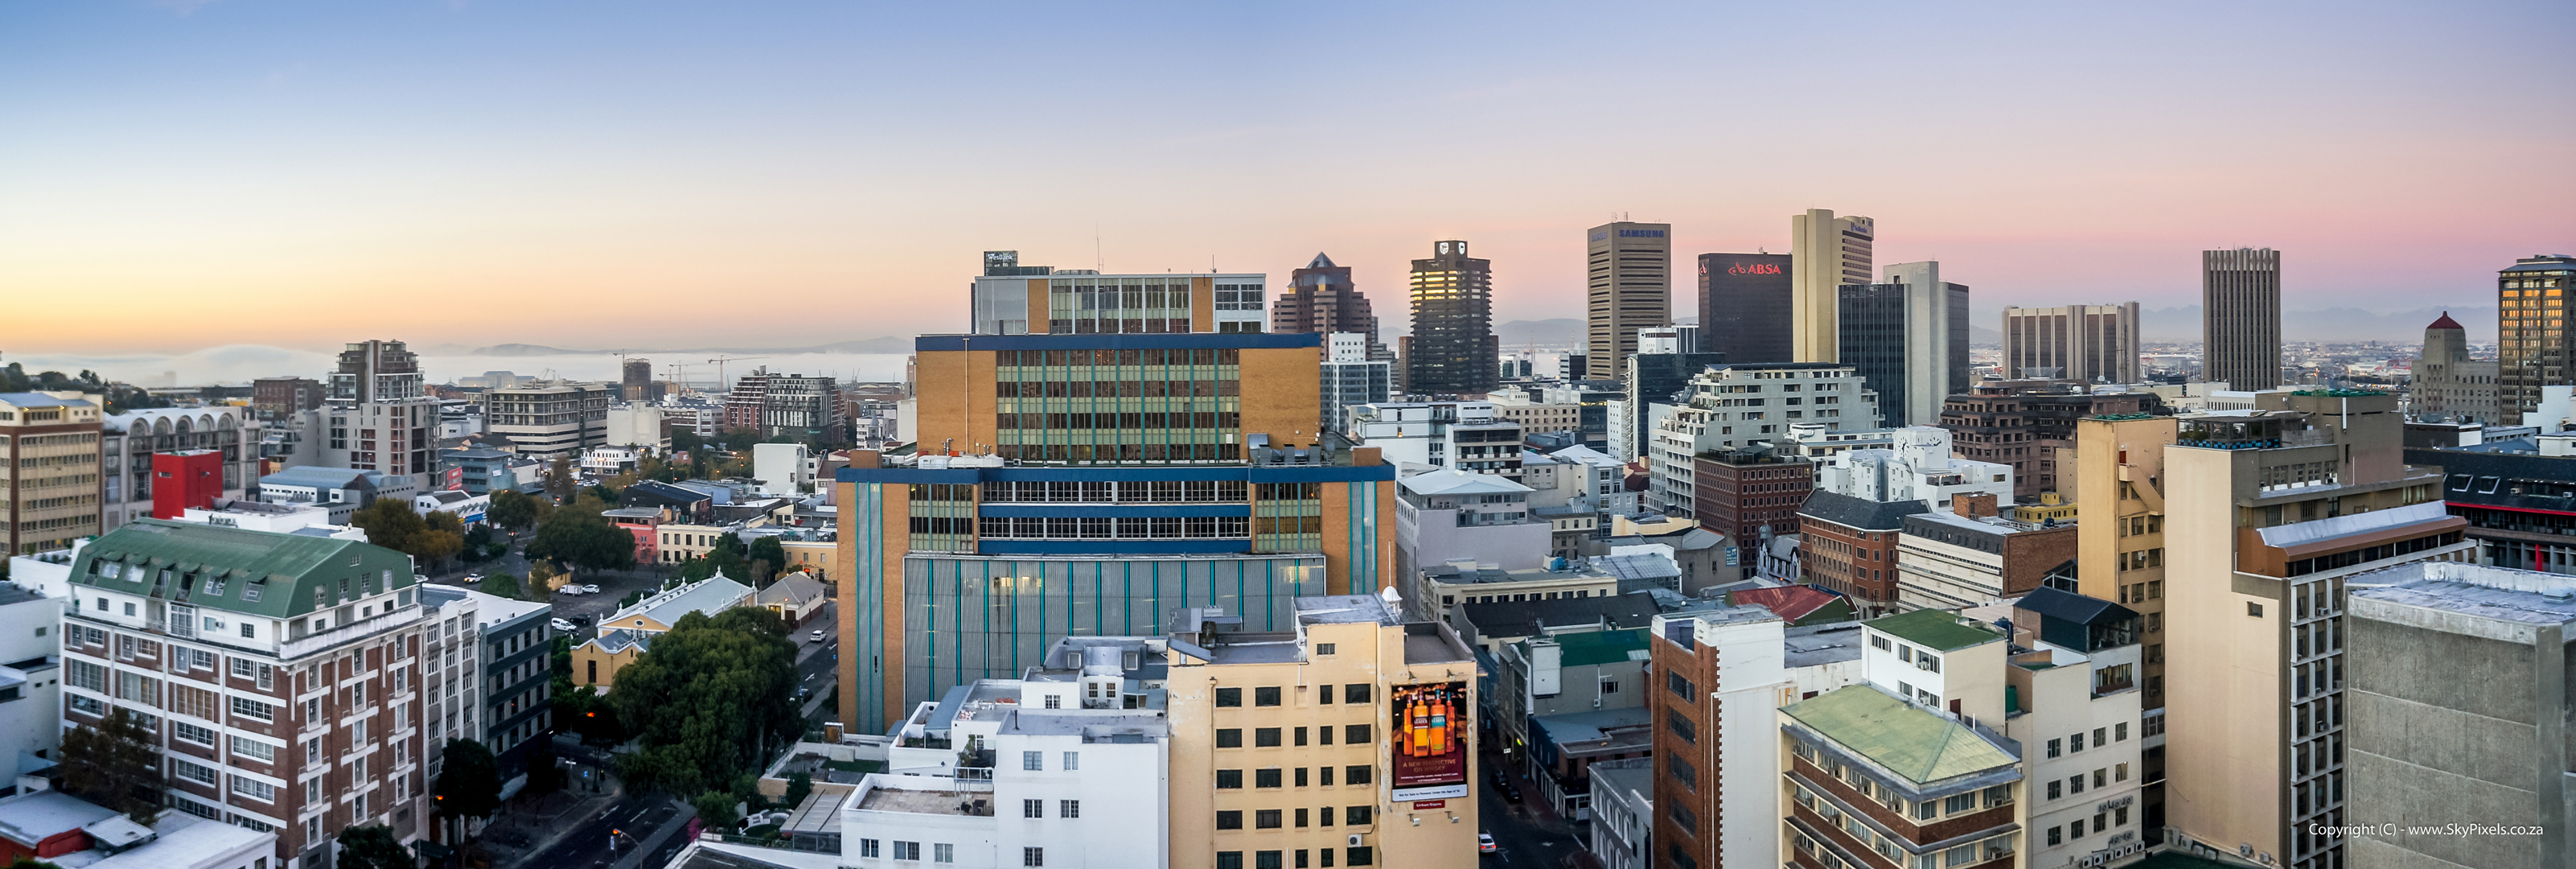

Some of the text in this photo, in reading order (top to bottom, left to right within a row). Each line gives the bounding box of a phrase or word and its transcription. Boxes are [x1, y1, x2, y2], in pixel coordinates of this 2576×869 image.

[1592, 230, 1608, 242] SAMSUNG
[1619, 229, 1664, 237] SAMSUNG
[1748, 264, 1781, 274] ABSA
